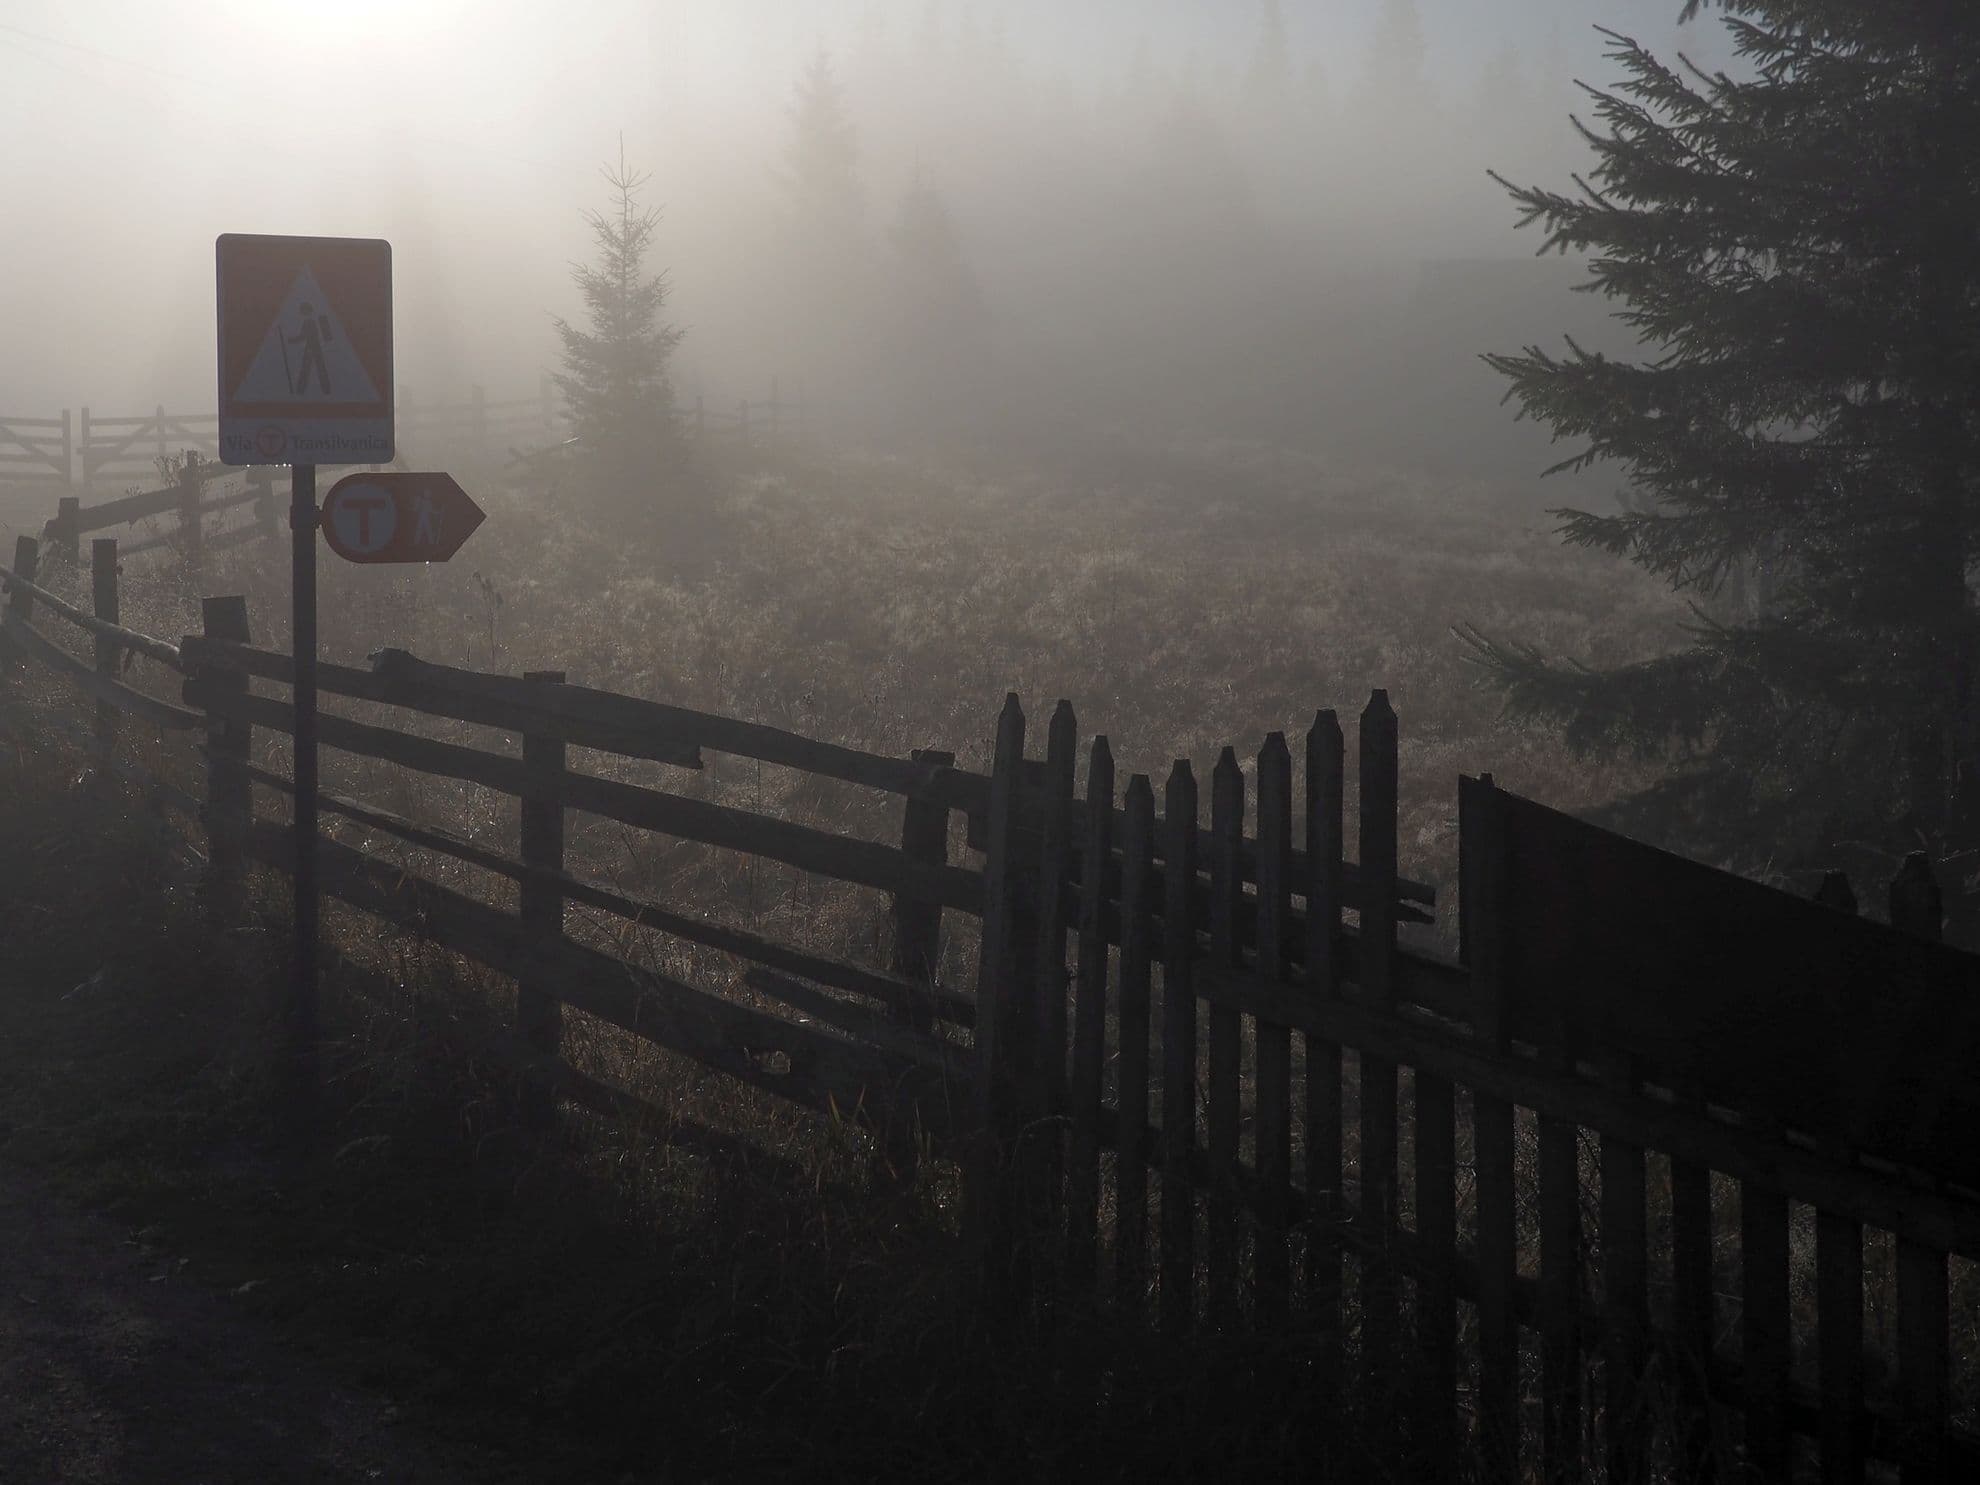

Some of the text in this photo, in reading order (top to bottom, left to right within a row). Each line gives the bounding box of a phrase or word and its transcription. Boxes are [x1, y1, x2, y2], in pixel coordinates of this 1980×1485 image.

[225, 434, 253, 450] Via
[289, 434, 388, 450] Transilvanica
[342, 498, 386, 545] T
